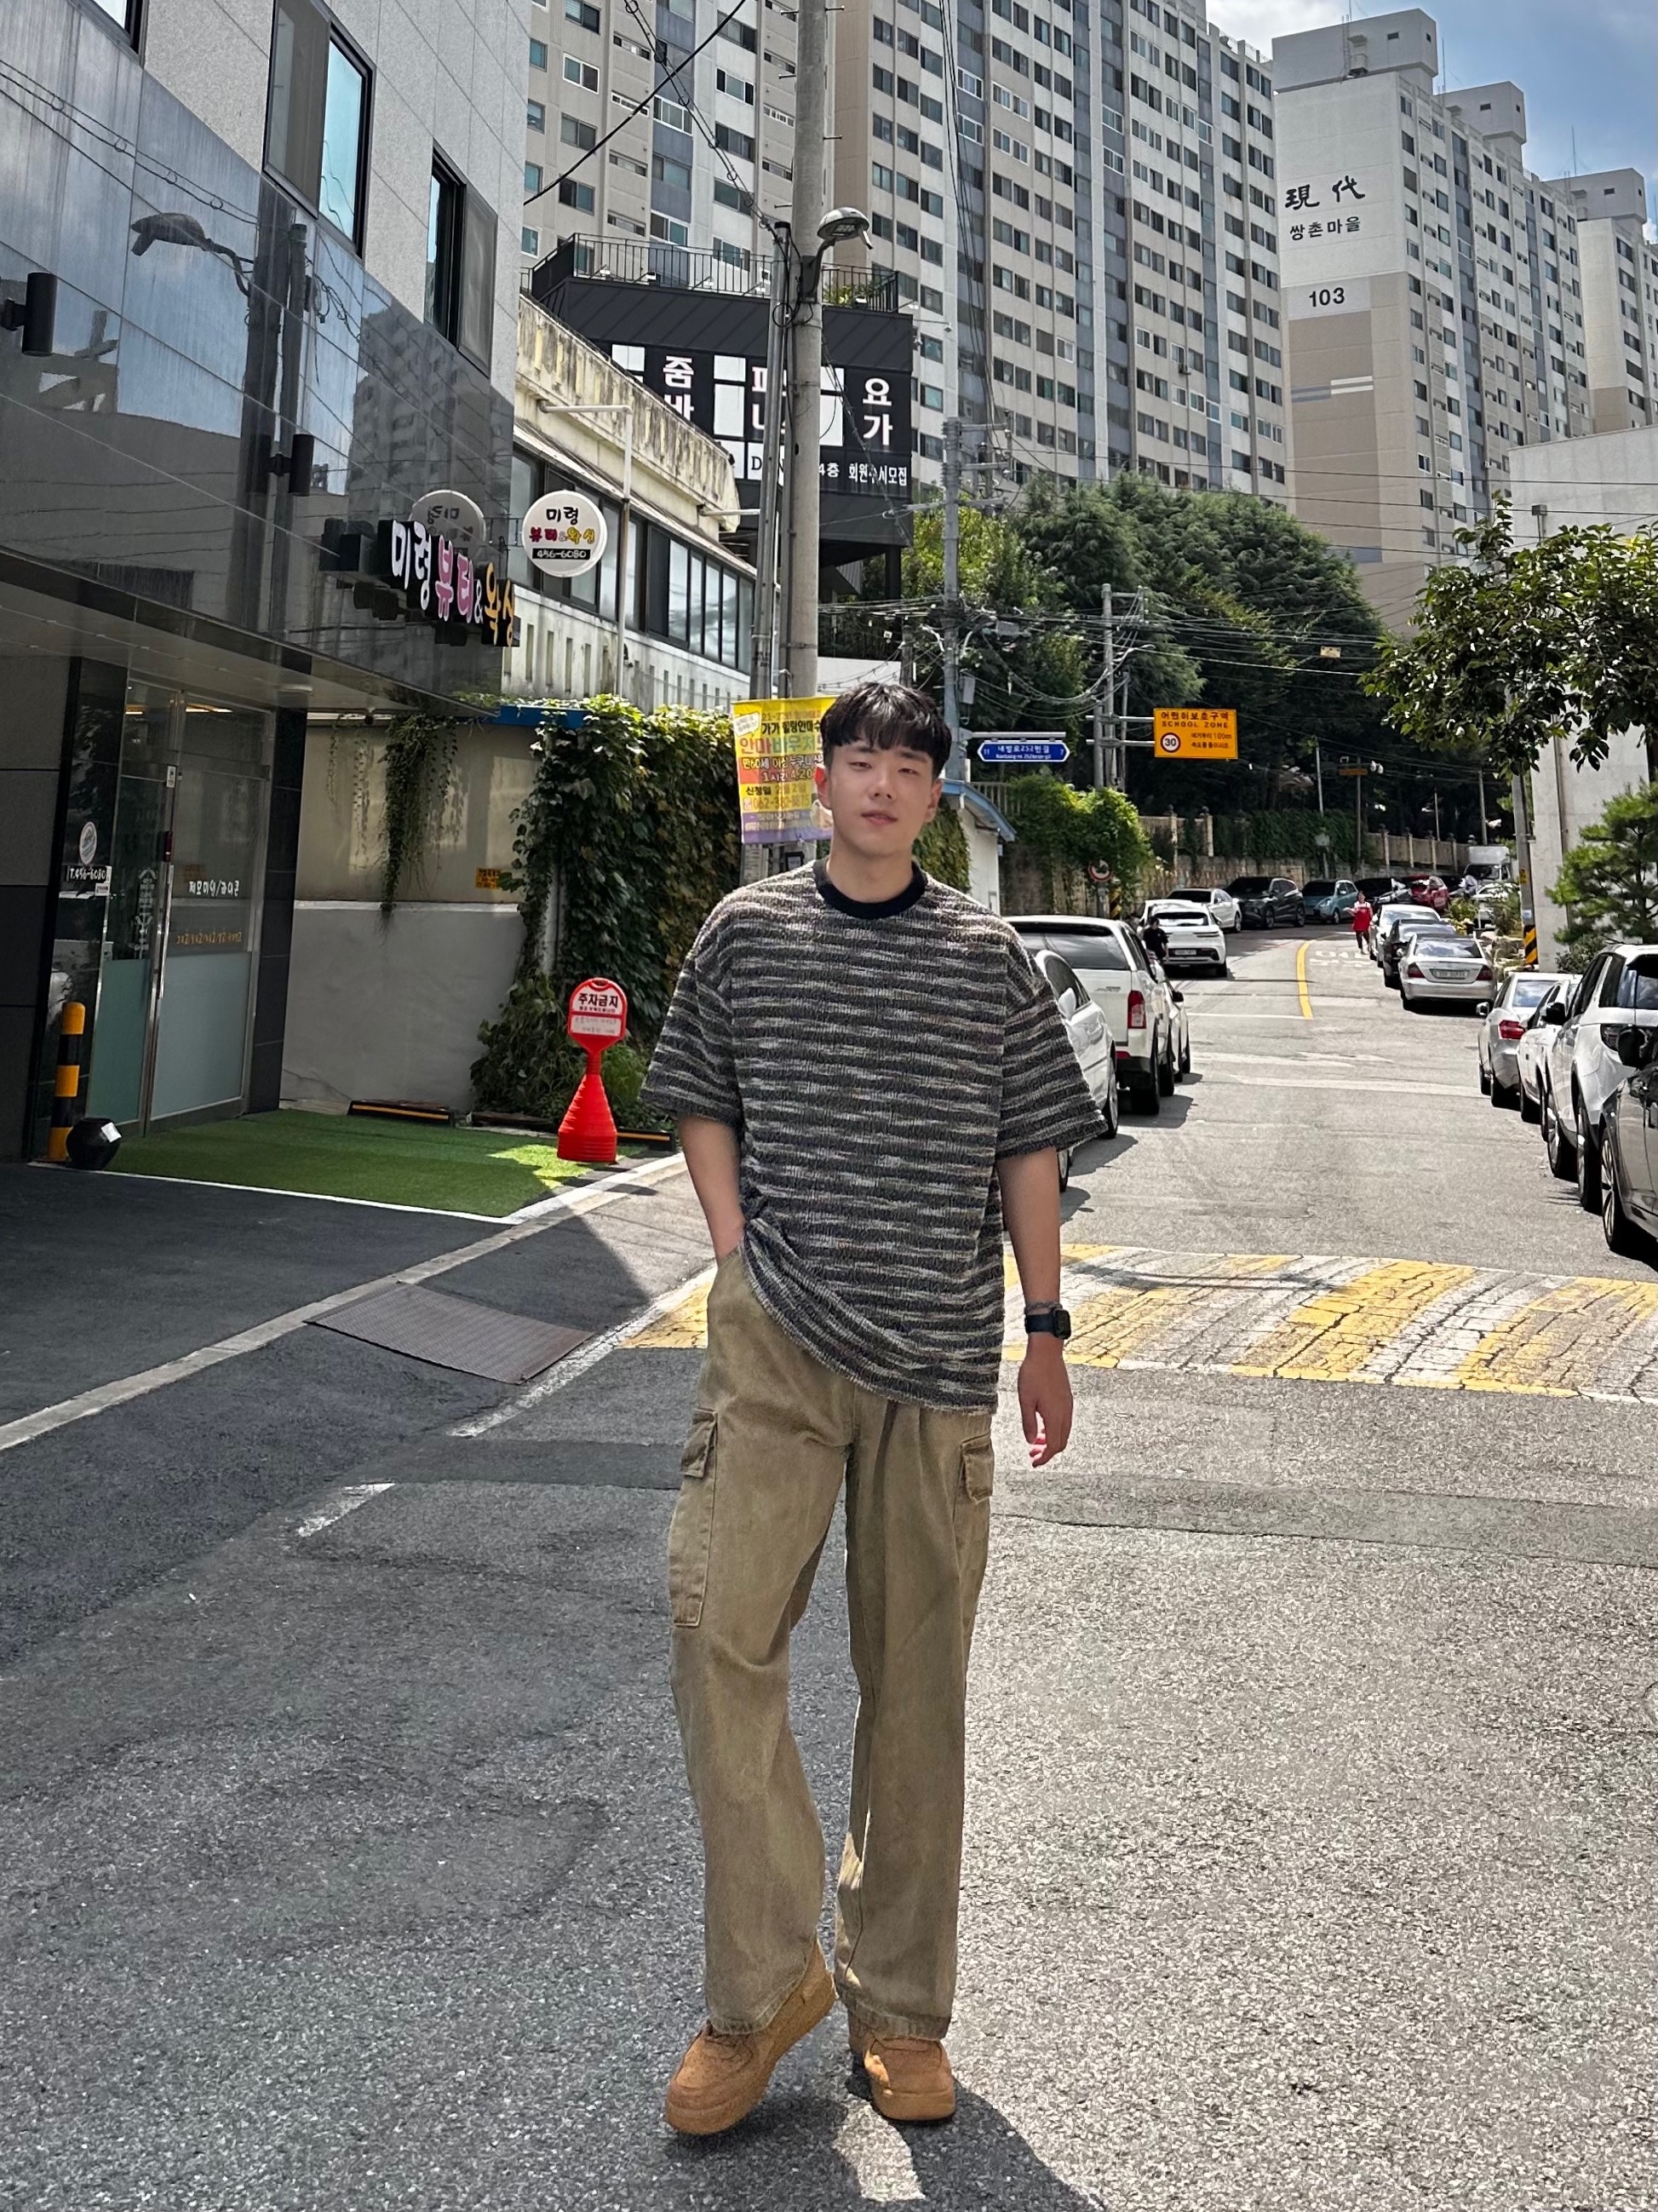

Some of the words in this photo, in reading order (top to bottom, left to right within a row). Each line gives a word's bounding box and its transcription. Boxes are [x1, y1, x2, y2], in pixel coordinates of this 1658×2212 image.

[1285, 175, 1366, 210] 現代
[1289, 215, 1361, 241] 쌍촌마을
[1309, 287, 1345, 307] 103
[863, 377, 893, 445] 요가
[546, 506, 579, 525] 미령
[536, 549, 587, 558] 456-6080
[392, 519, 433, 611] 미령
[1161, 711, 1229, 721] 어린이보호구역
[1164, 738, 1177, 746] 30
[578, 993, 618, 1008] 주차금지
